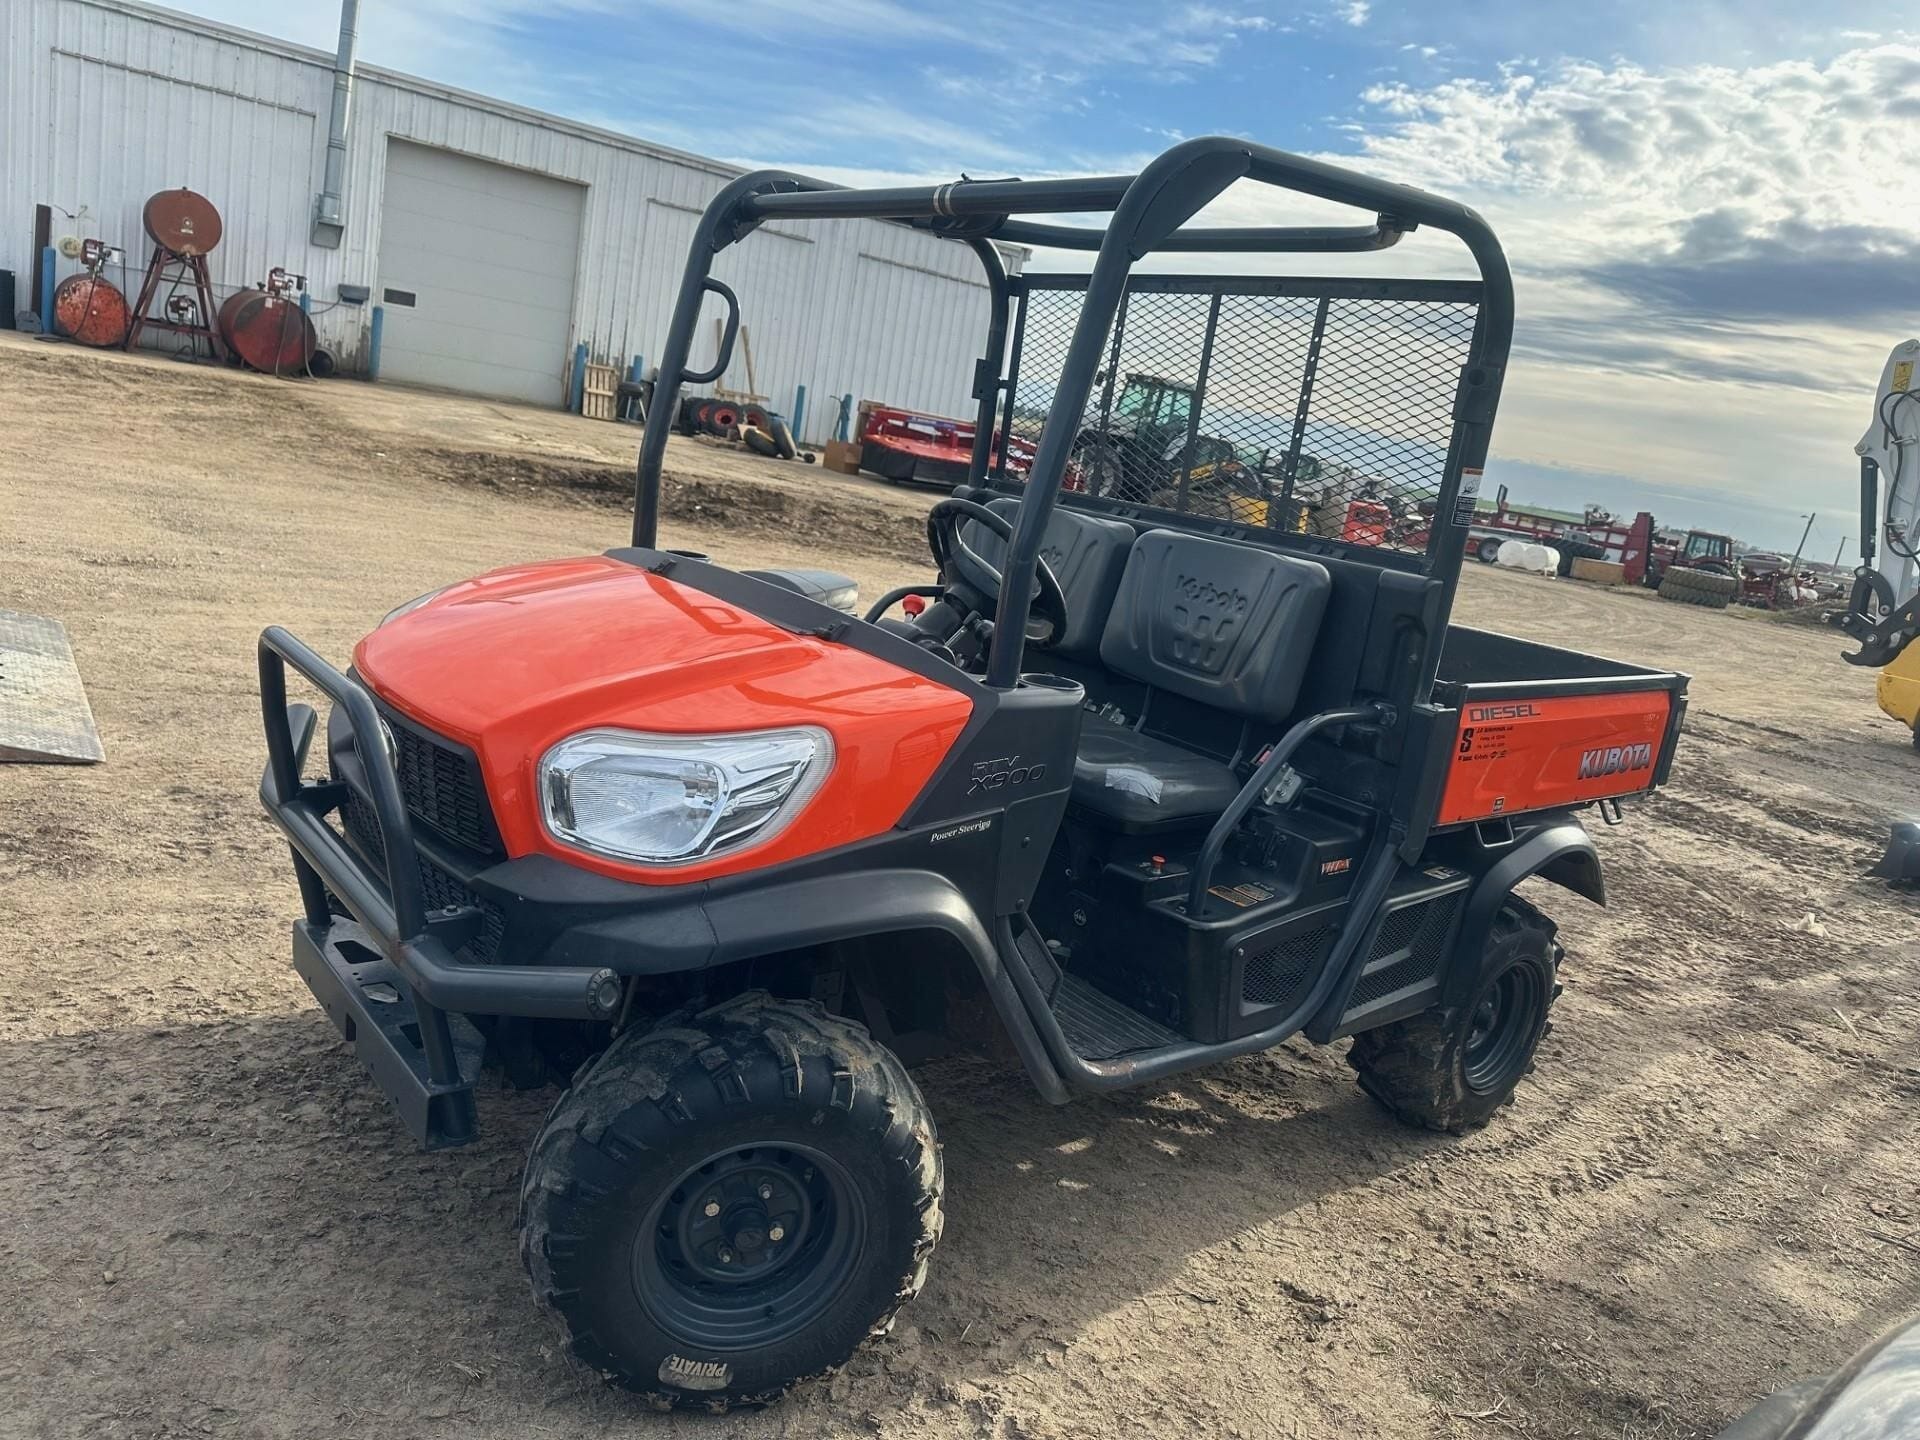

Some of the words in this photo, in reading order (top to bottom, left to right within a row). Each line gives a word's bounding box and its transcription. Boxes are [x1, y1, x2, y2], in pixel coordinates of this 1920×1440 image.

[1469, 704, 1541, 722] DIESEL
[1577, 743, 1652, 780] KUBOTA
[966, 764, 1047, 795] X900
[930, 829, 958, 843] Power
[669, 1356, 728, 1377] PRIVATE
